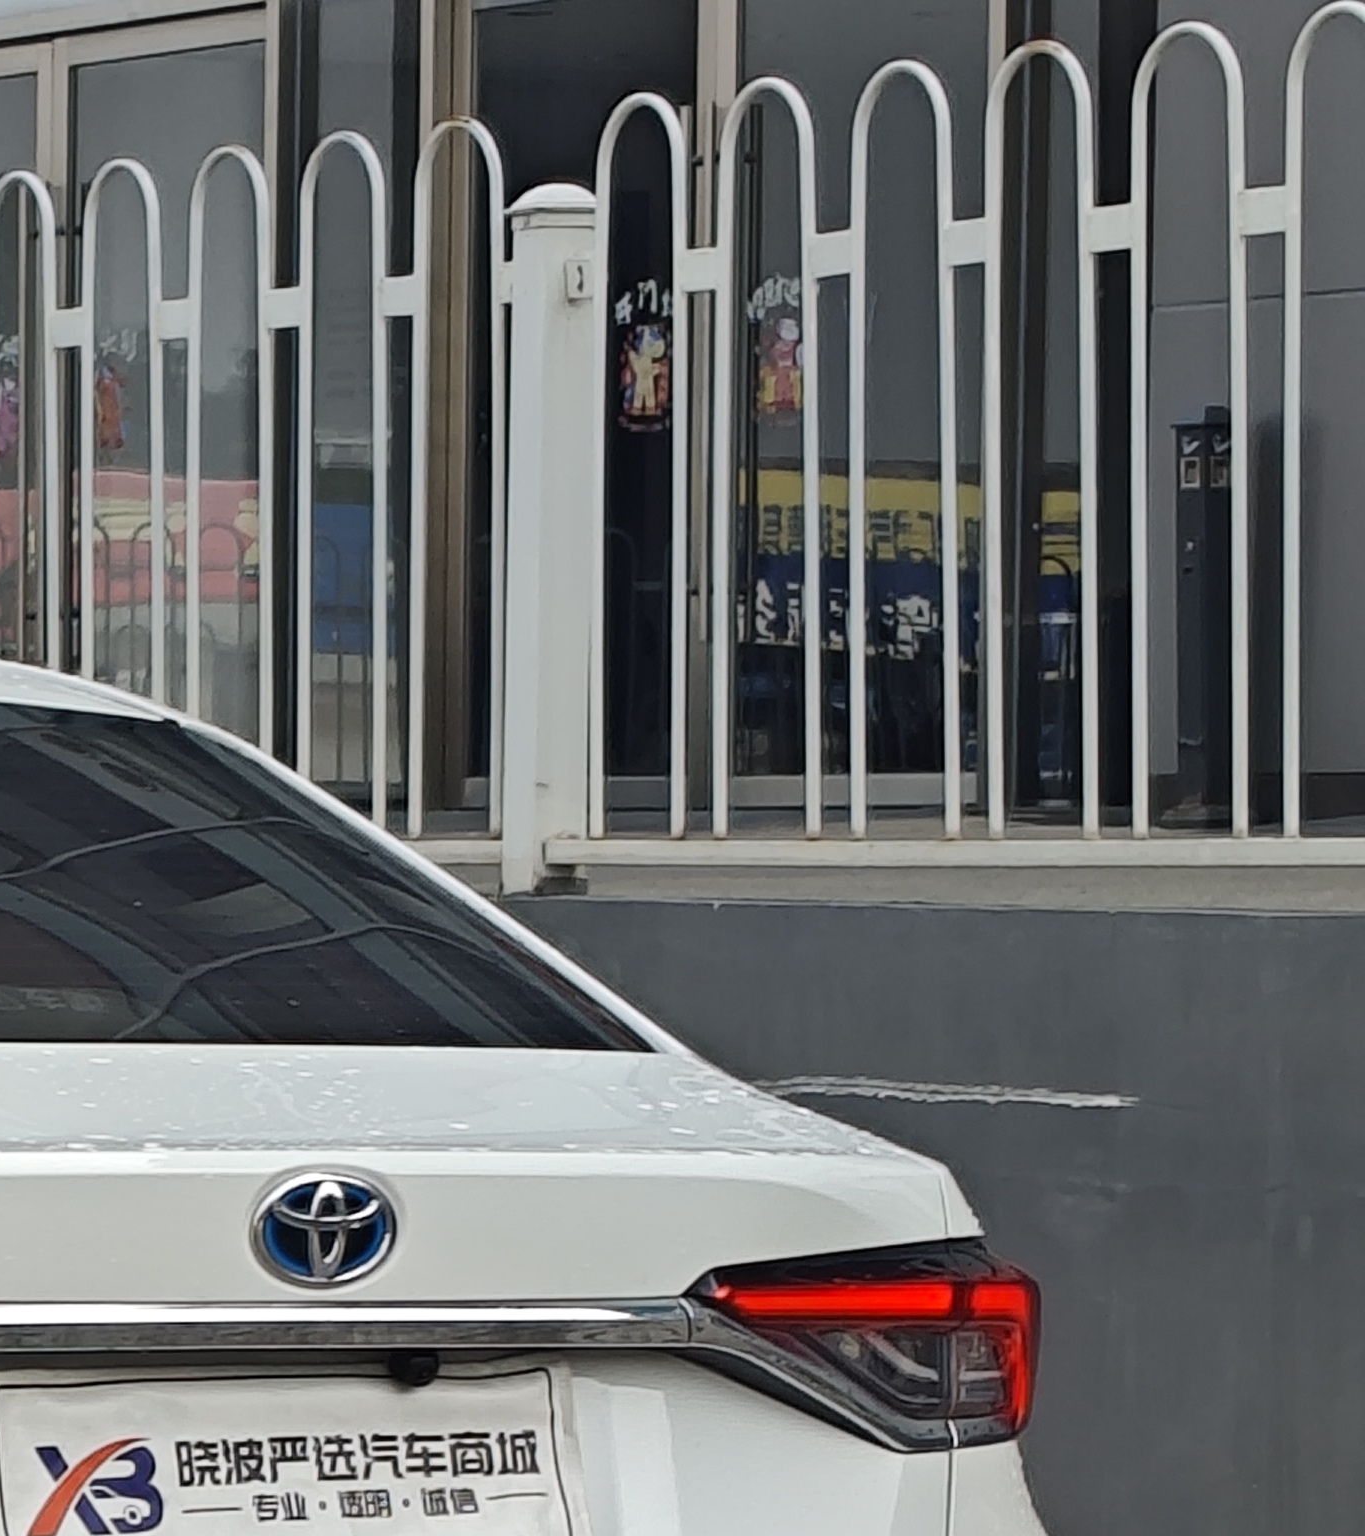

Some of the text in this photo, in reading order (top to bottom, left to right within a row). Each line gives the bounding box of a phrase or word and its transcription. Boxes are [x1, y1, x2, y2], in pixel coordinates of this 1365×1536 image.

[174, 1429, 542, 1488] 晓波严选汽车商城
